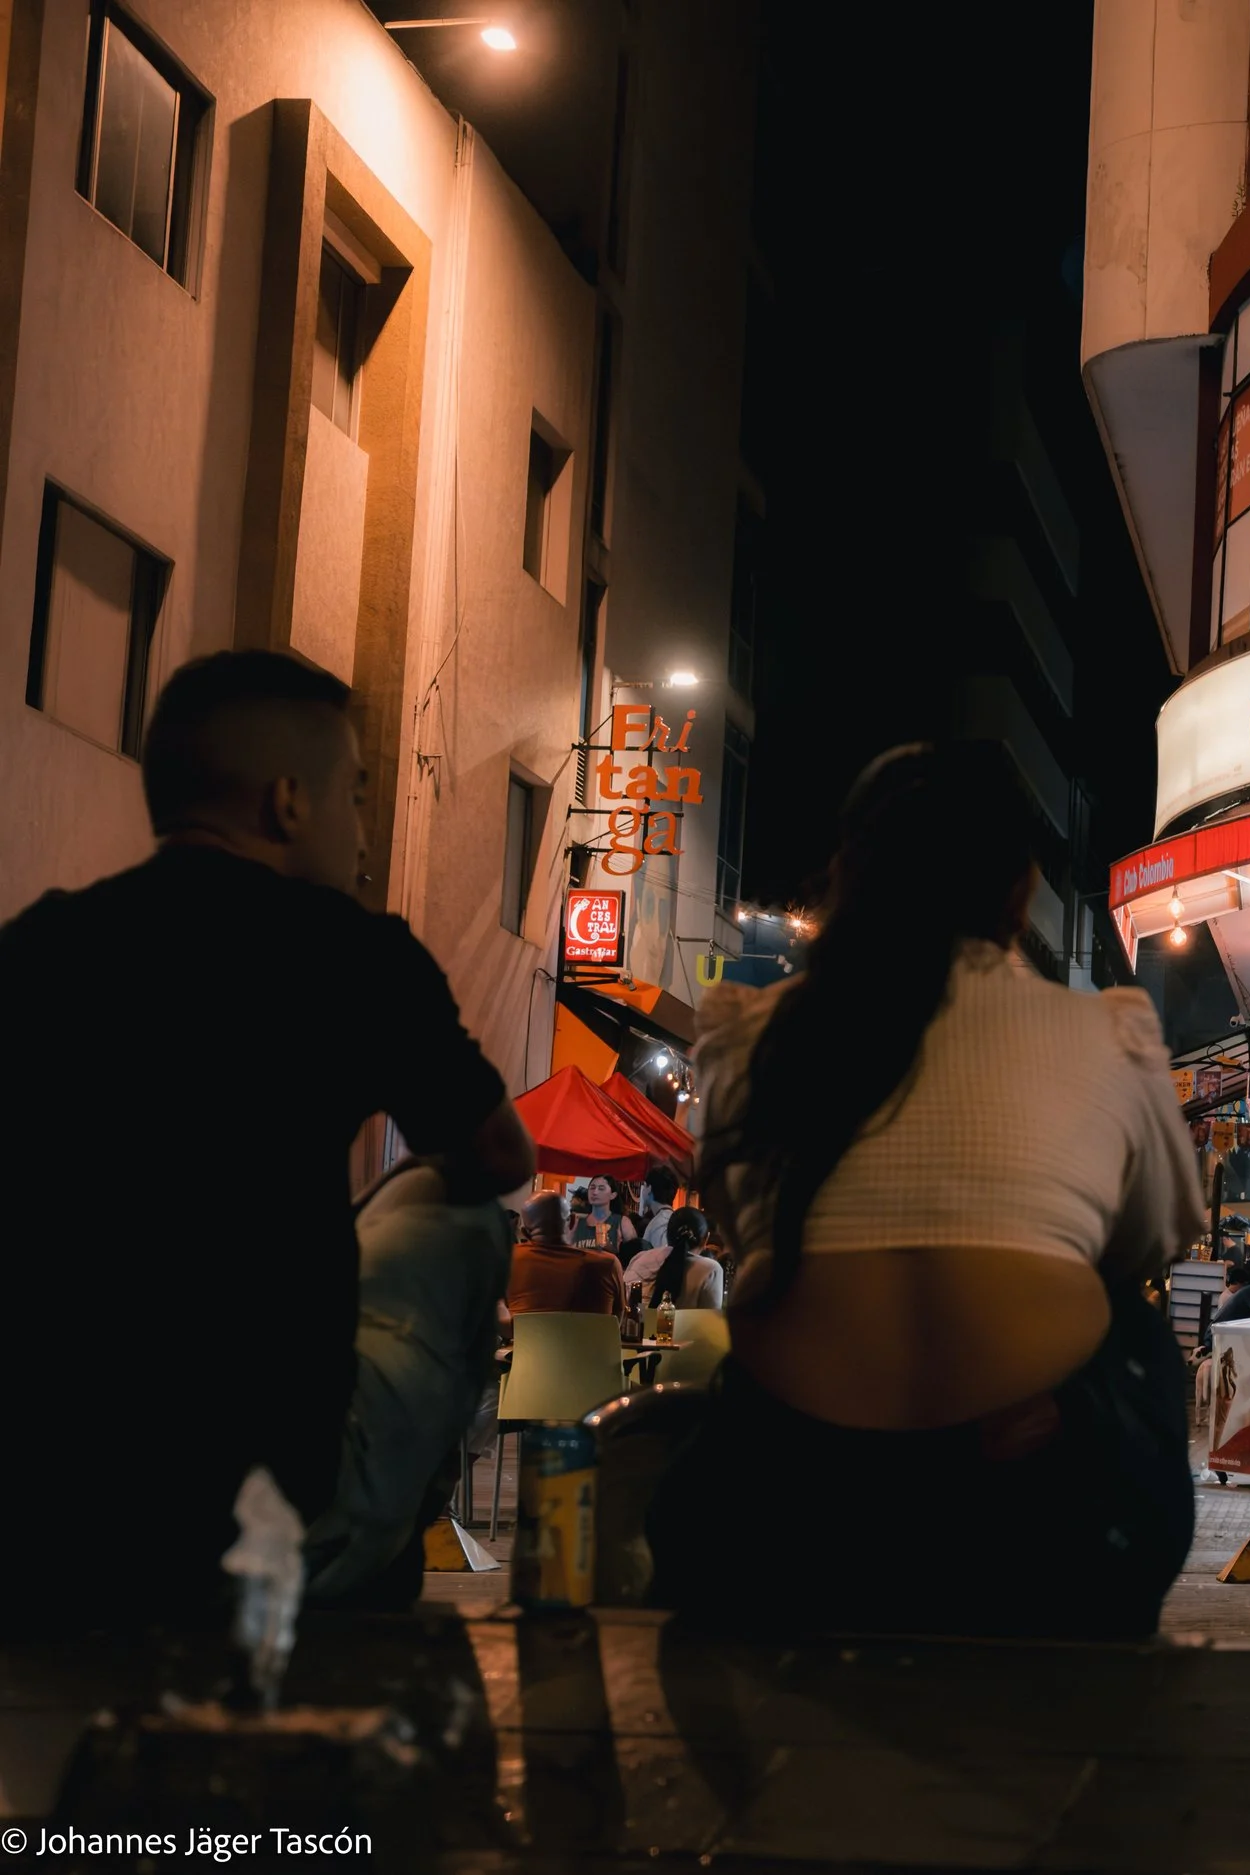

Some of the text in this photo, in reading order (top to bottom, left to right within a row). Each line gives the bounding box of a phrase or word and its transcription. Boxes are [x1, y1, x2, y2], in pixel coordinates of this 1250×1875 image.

[611, 704, 697, 753] Fri
[596, 754, 704, 804] tan
[601, 804, 685, 876] ga
[1139, 853, 1174, 889] Colombia
